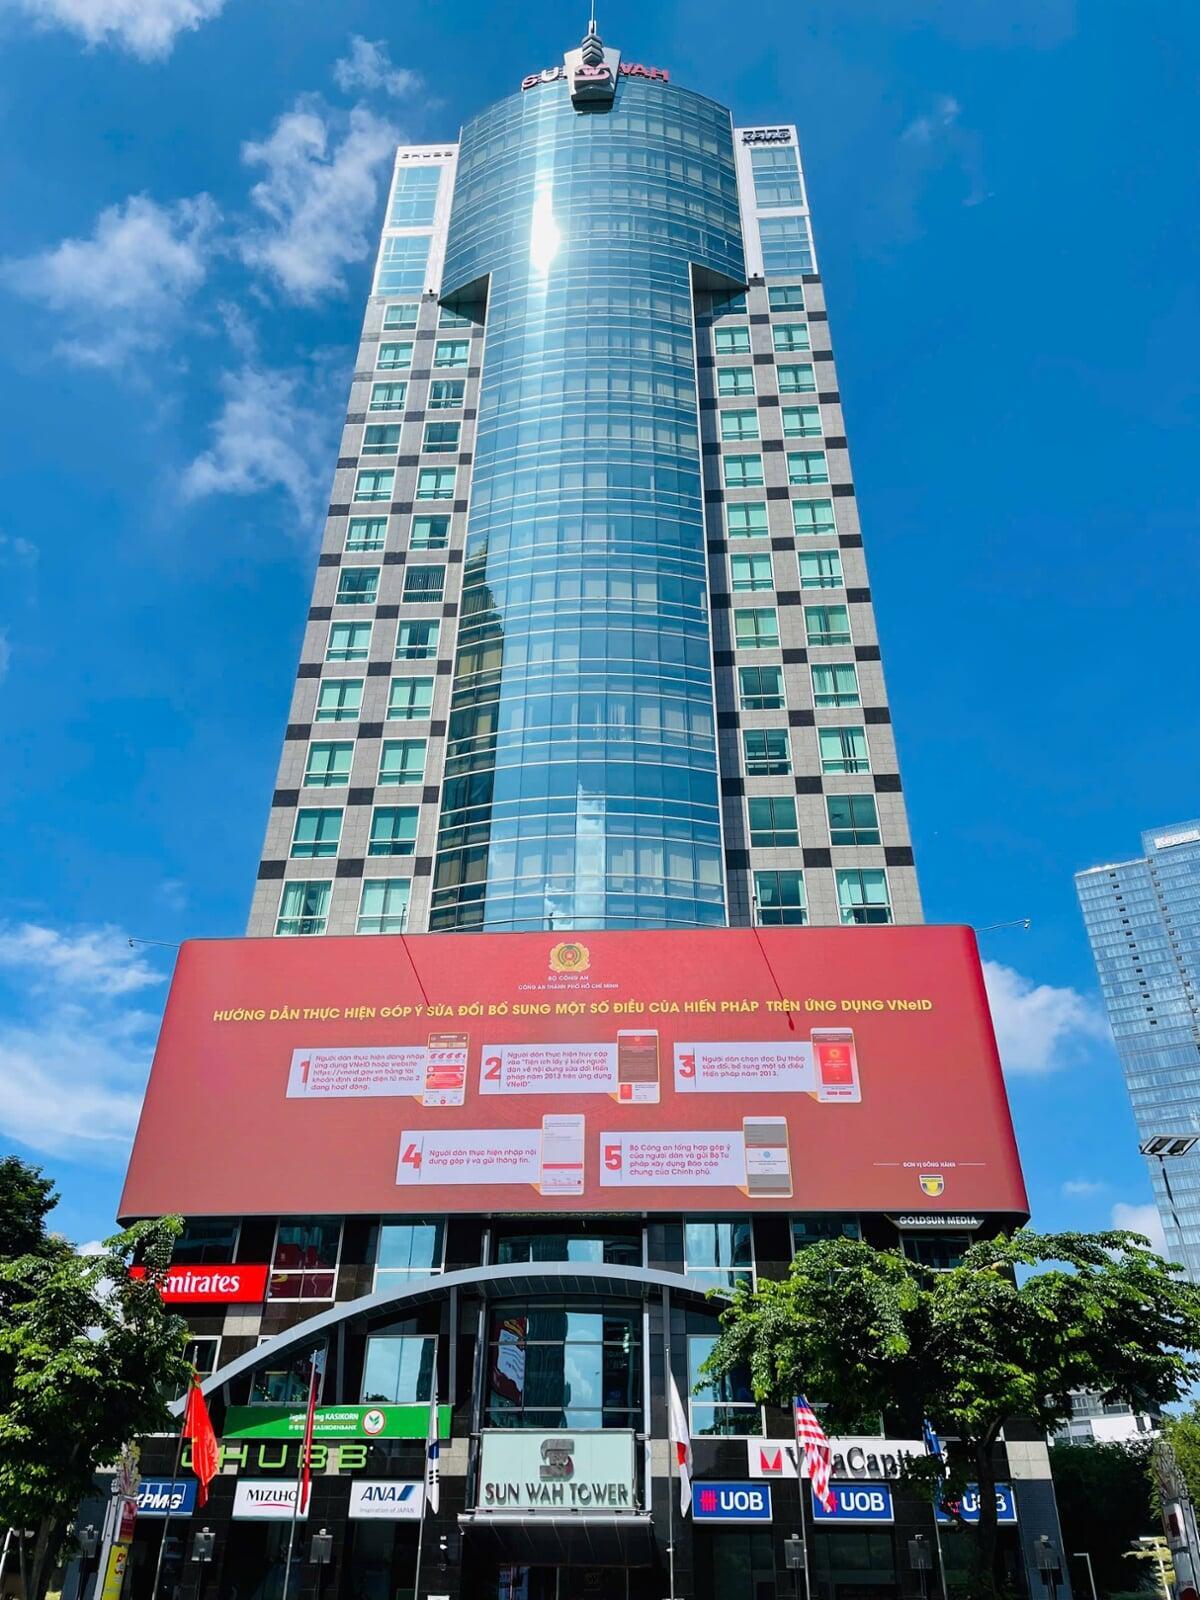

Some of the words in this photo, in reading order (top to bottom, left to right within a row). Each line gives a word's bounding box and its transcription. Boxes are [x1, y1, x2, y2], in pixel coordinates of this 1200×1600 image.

[522, 66, 567, 91] SU
[213, 1007, 266, 1021] HƯỚNG
[269, 1005, 300, 1020] DẪN
[303, 1006, 340, 1021] THỰC
[344, 1005, 376, 1020] HIỆN
[380, 1004, 412, 1017] GÓP
[415, 1004, 423, 1016] Ý
[427, 1003, 454, 1016] SỬA
[458, 1001, 483, 1016] ĐỔI
[488, 1001, 508, 1015] BỔ
[512, 1003, 551, 1014] SUNG
[555, 1001, 586, 1016] MỘT
[590, 1000, 609, 1013] SỐ
[613, 998, 644, 1013] ĐIỀU
[649, 999, 680, 1013] CỦA
[684, 998, 716, 1012] HIẾN
[721, 998, 759, 1012] PHÁP
[766, 999, 800, 1011] TRÊN
[804, 998, 837, 1011] ỨNG
[841, 1000, 884, 1013] DỤNG
[887, 999, 932, 1010] VNeID
[301, 1060, 310, 1083] 1
[485, 1056, 502, 1080] 2
[679, 1055, 695, 1078] 3
[402, 1144, 422, 1169] 4
[605, 1145, 622, 1171] 5
[900, 1216, 945, 1225] GOLDSUN
[947, 1216, 978, 1225] MEDIA
[159, 1271, 240, 1294] mirates
[136, 1493, 183, 1509] KPMG
[247, 1489, 298, 1502] MIZUHO
[360, 1486, 396, 1502] ANA
[485, 1483, 520, 1505] SUN
[525, 1483, 564, 1505] WAH
[569, 1483, 629, 1505] TOWER
[720, 1491, 764, 1511] UOB
[840, 1491, 885, 1511] UOB
[962, 1493, 1007, 1512] UB
